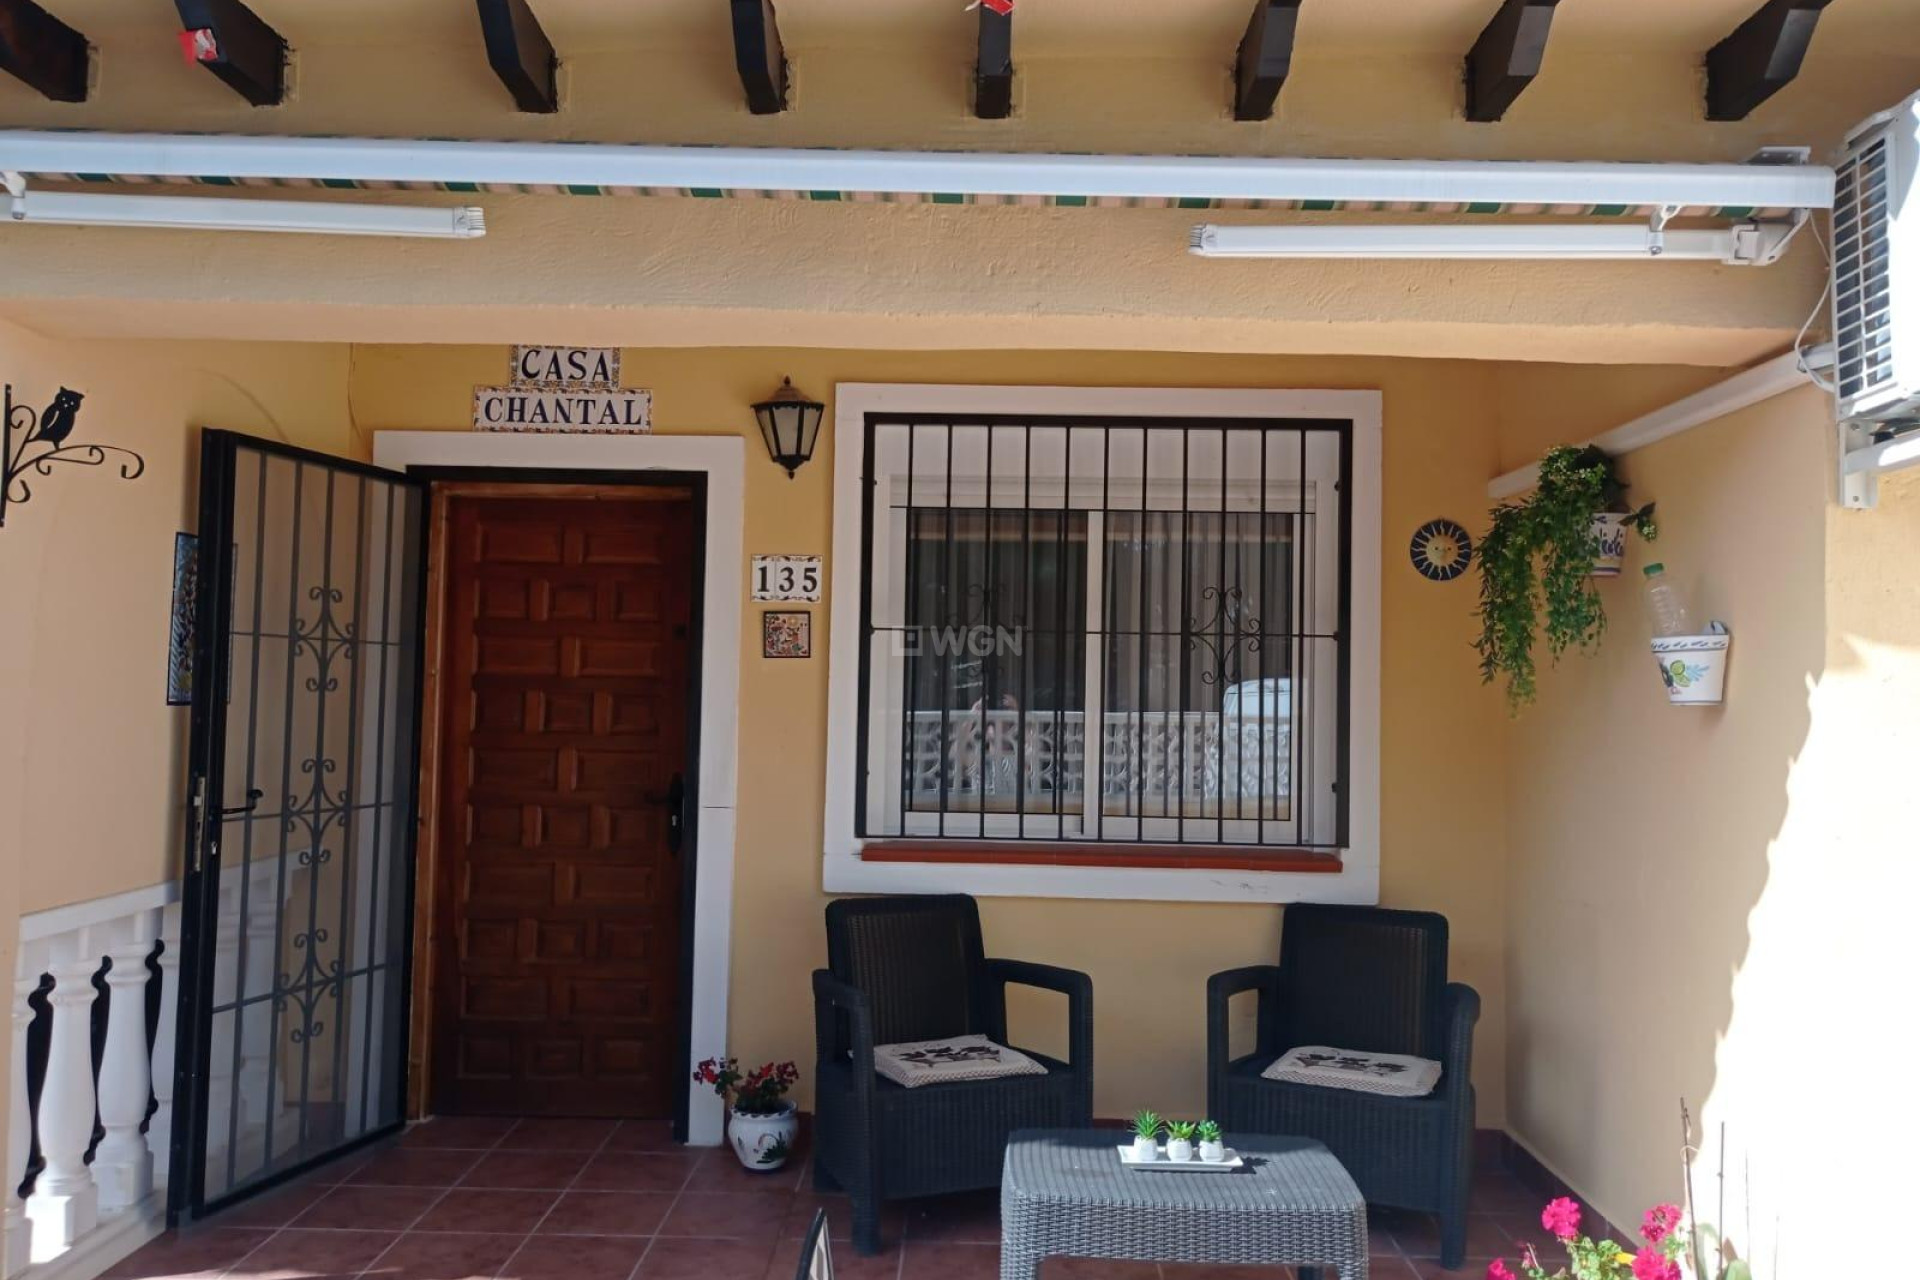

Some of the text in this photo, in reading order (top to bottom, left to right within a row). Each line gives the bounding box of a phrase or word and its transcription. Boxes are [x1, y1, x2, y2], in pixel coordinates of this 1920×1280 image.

[521, 350, 610, 381] CASA
[485, 397, 642, 425] CHANTAL
[757, 566, 818, 592] 135
